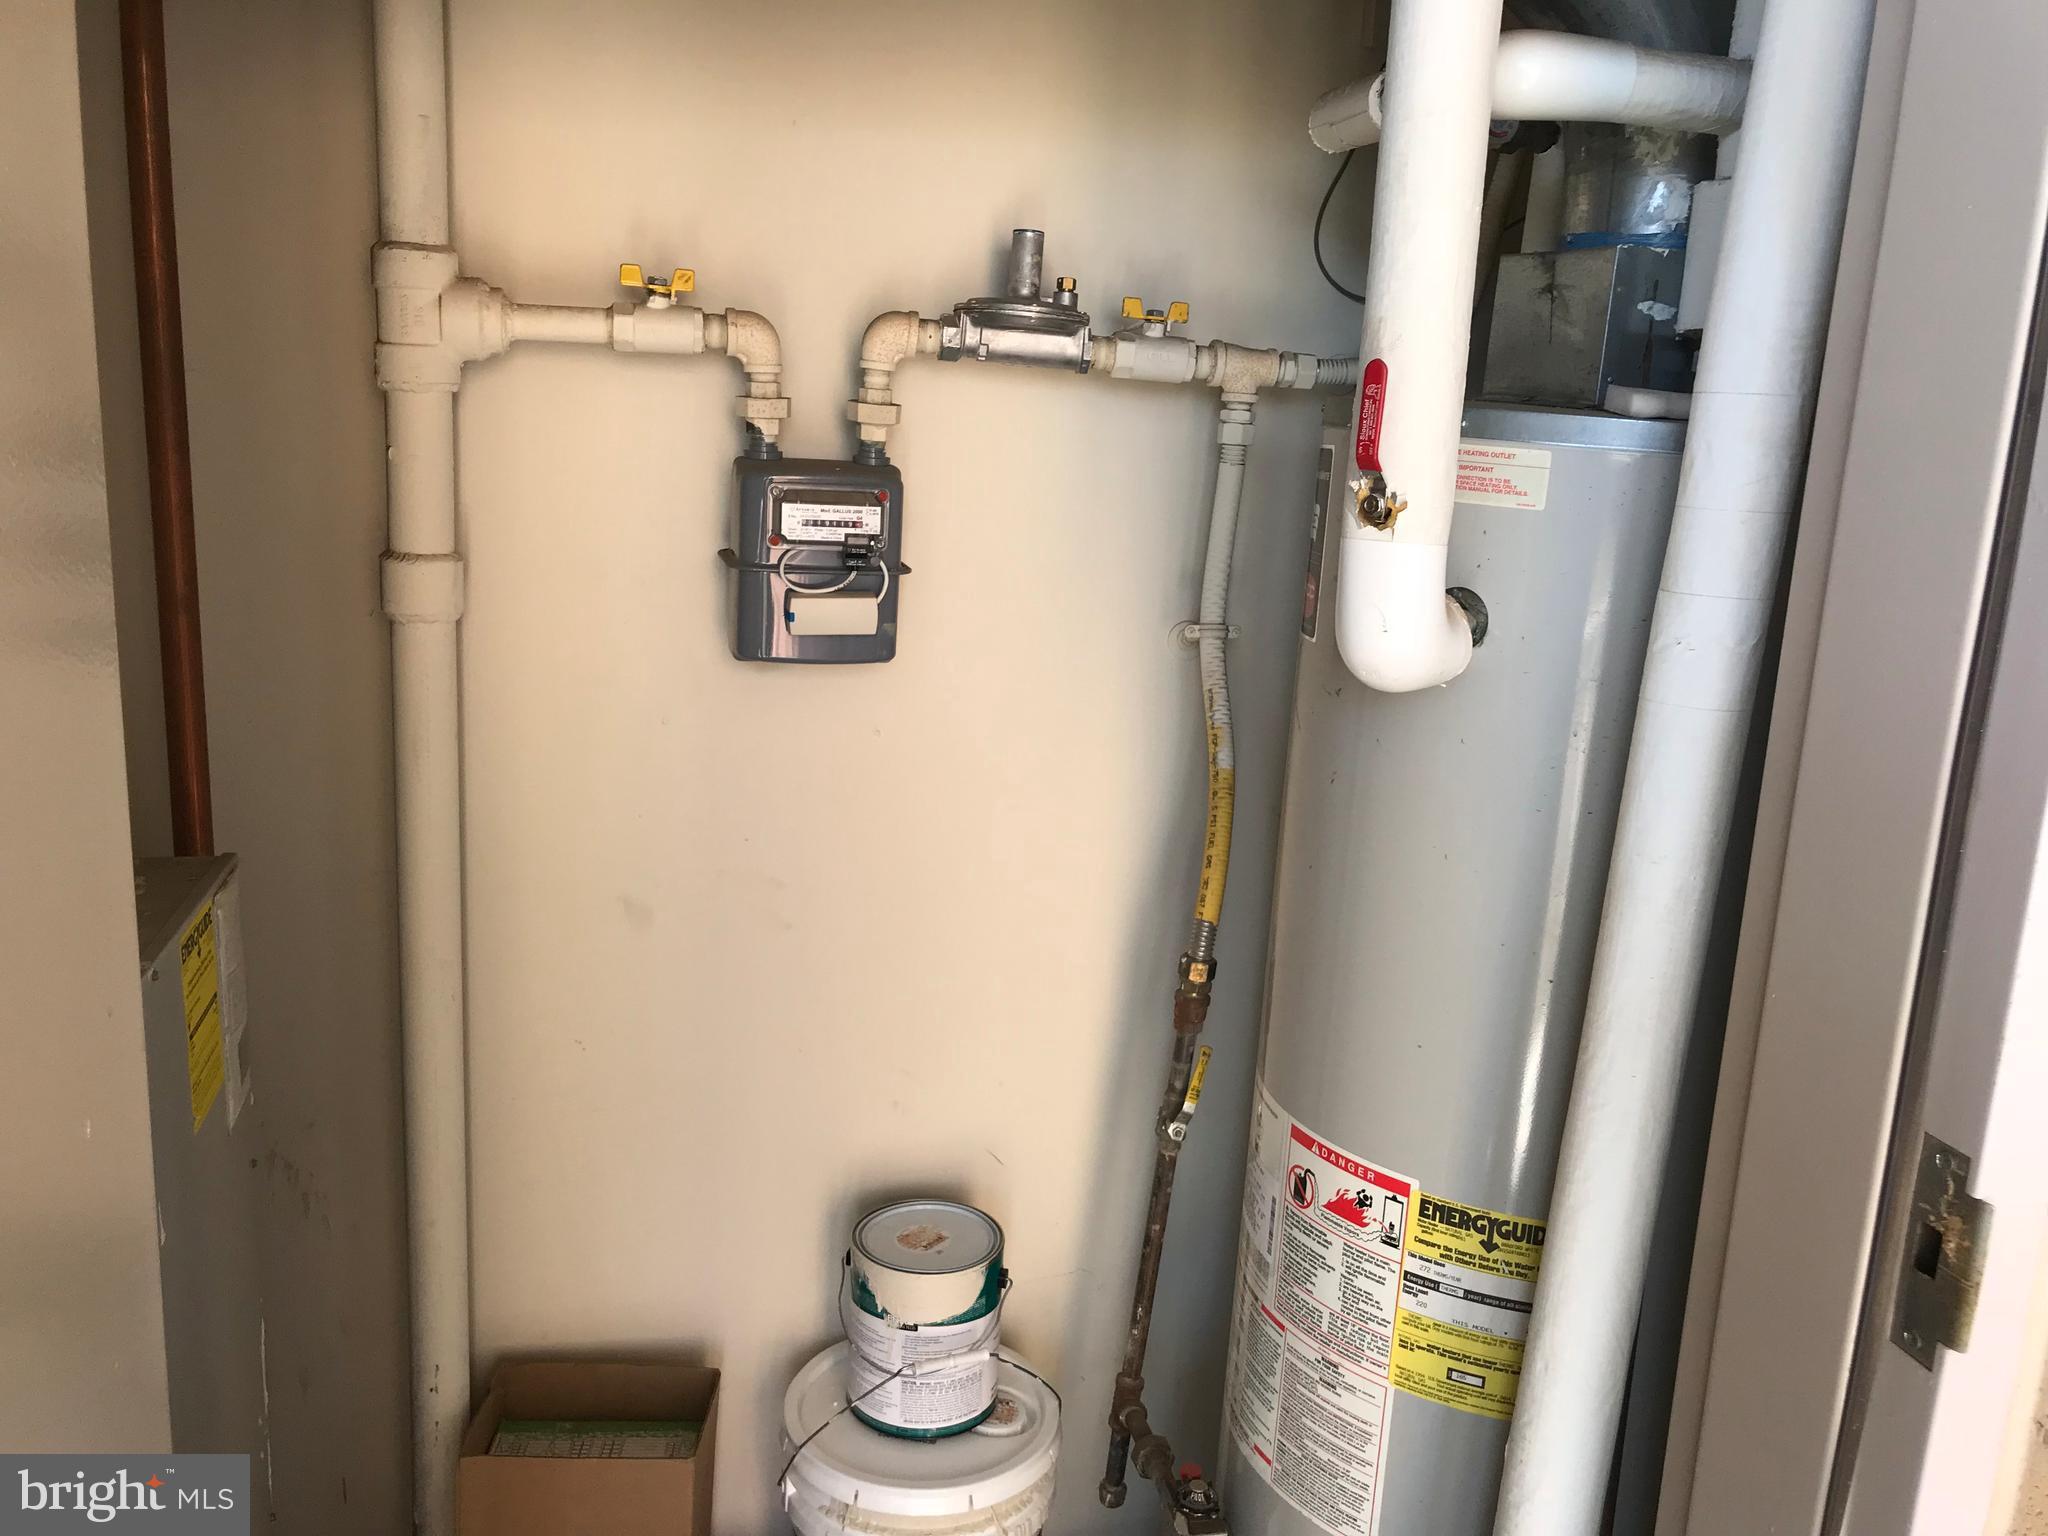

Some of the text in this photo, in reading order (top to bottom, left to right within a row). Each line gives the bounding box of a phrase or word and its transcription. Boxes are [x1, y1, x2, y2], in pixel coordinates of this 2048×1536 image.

[1463, 449, 1489, 457] HEATING
[1490, 452, 1516, 460] OUTLET
[1459, 464, 1494, 473] IMPORTANT
[1456, 474, 1487, 482] ONNECTION
[1477, 481, 1501, 489] HEATING
[1207, 832, 1216, 850] FUEL
[1321, 1147, 1376, 1182] DANGER
[1419, 1197, 1546, 1246] ENERGYGUID
[1414, 1235, 1442, 1250] Compare
[1443, 1246, 1453, 1254] the
[1454, 1248, 1477, 1261] Energy
[1478, 1254, 1490, 1264] Use
[1514, 1260, 1536, 1272] Water
[1418, 1254, 1433, 1264] Model
[1419, 1264, 1431, 1274] 272
[1439, 1252, 1453, 1262] with
[1454, 1255, 1477, 1268] Others
[1478, 1262, 1500, 1274] Before
[1515, 1268, 1530, 1280] Buy.
[1406, 1274, 1424, 1285] Energy
[1424, 1279, 1435, 1288] Use
[1441, 1284, 1460, 1294] THERMS
[1415, 1286, 1429, 1297] Least
[1415, 1299, 1428, 1309] 220
[1452, 1319, 1495, 1334] THIS MODEL
